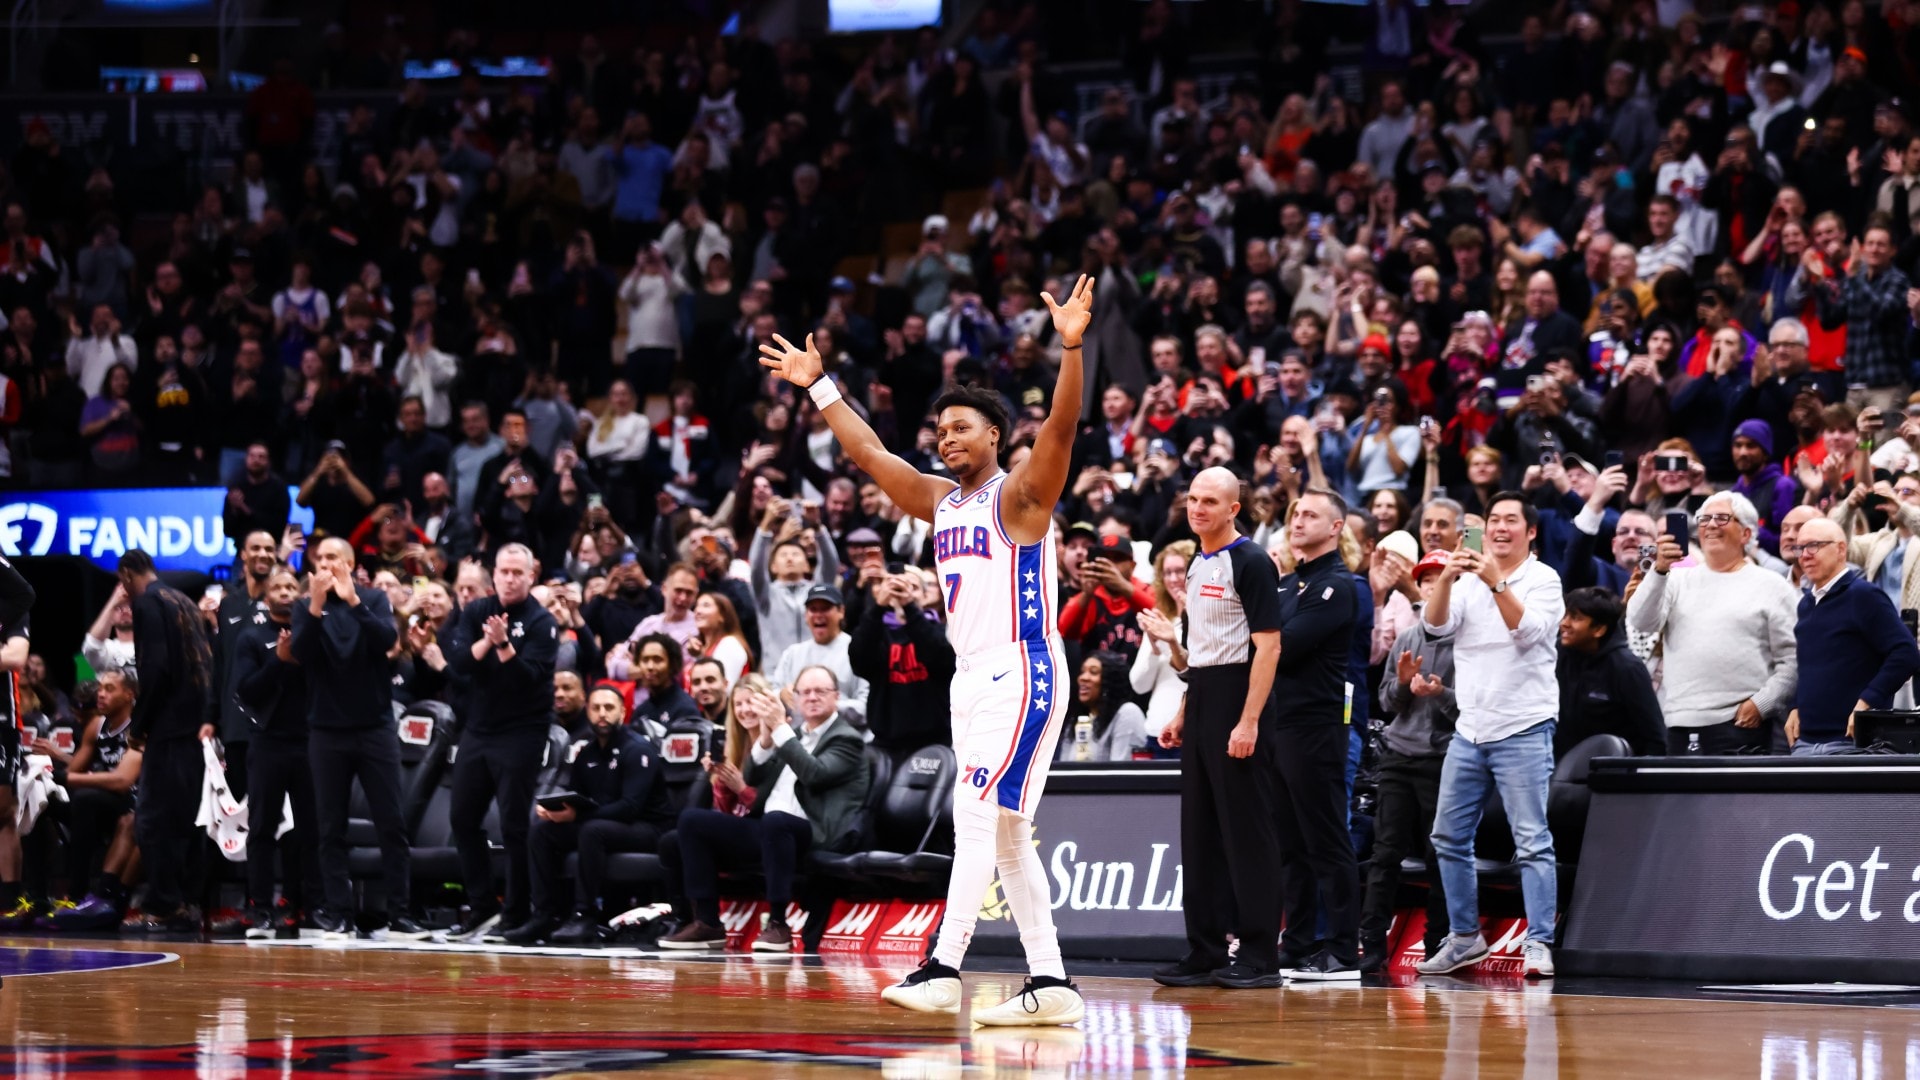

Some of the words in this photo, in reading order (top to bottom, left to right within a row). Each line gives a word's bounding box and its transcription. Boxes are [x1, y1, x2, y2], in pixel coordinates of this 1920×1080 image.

[69, 516, 237, 557] FANDU
[945, 573, 962, 613] 7
[961, 764, 990, 788] 76
[1050, 841, 1134, 911] Sun
[1758, 833, 1889, 922] Get
[876, 941, 920, 952] MAGELLAN
